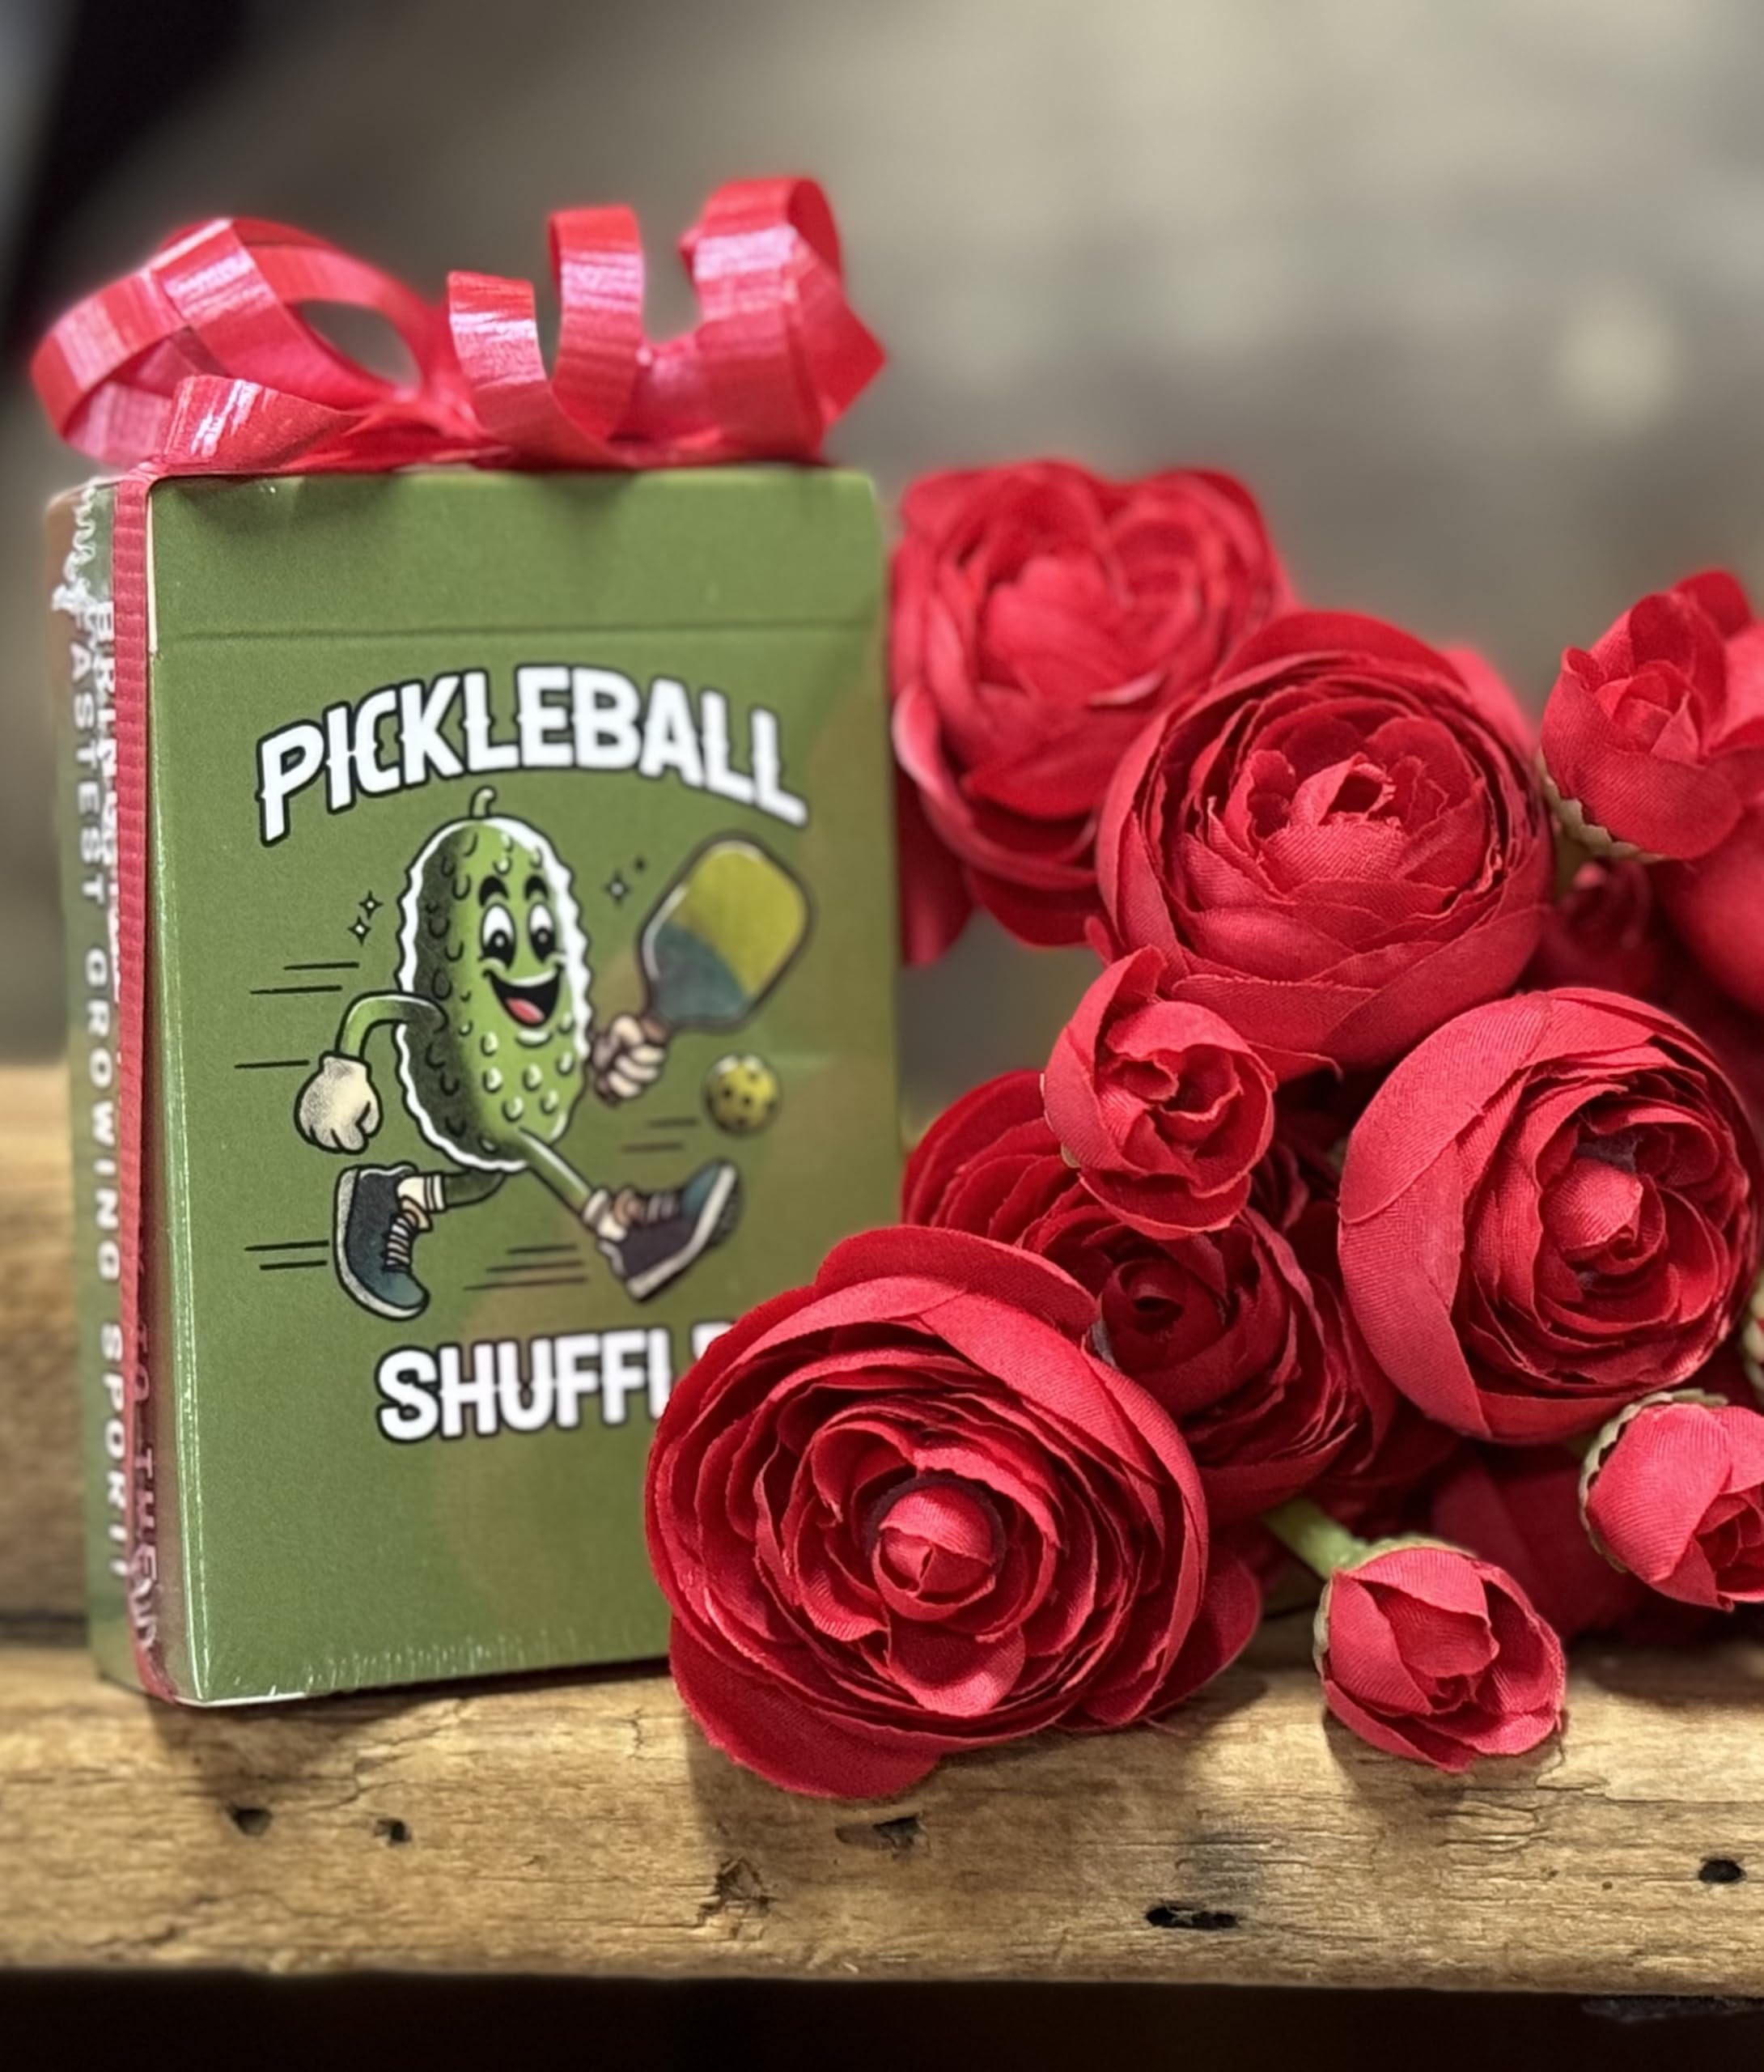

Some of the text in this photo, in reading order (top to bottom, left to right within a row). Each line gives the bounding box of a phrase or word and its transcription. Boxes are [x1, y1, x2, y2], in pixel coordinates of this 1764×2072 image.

[257, 664, 809, 846] PICKLEBALL
[85, 948, 120, 1280] GROWING
[375, 1322, 735, 1442] SHUFFL
